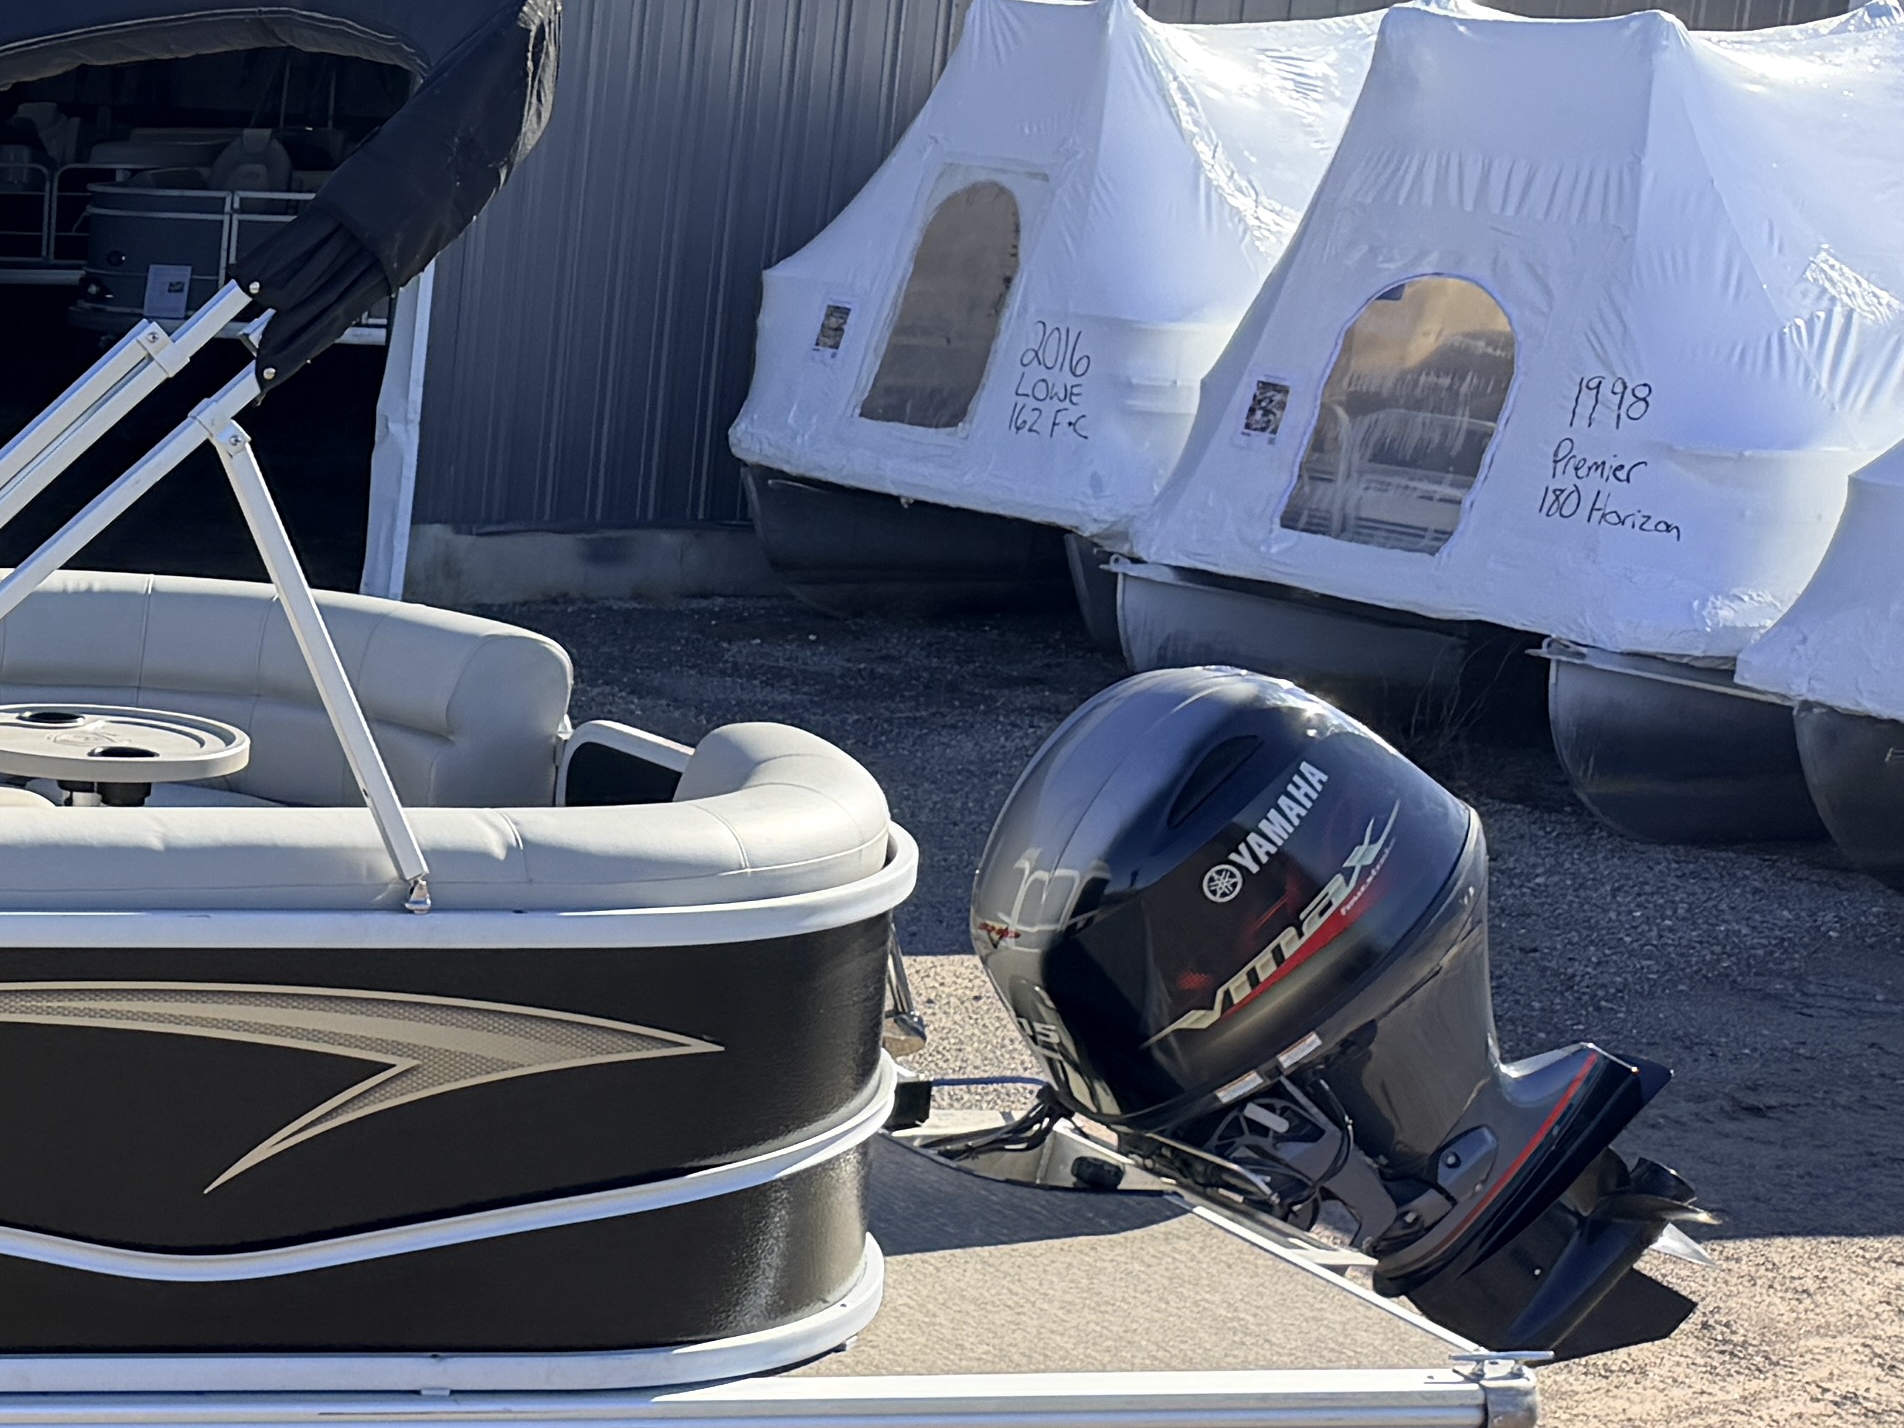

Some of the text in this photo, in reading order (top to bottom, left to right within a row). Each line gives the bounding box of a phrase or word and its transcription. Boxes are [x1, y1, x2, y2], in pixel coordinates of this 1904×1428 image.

[1020, 320, 1091, 378] 2016
[1015, 371, 1084, 406] LOWE
[1569, 376, 1653, 430] 1998
[1009, 401, 1040, 434] 162
[1552, 437, 1648, 484] Premier
[1539, 483, 1681, 542] 180 Horizon
[1228, 760, 1329, 875] YAMAHA
